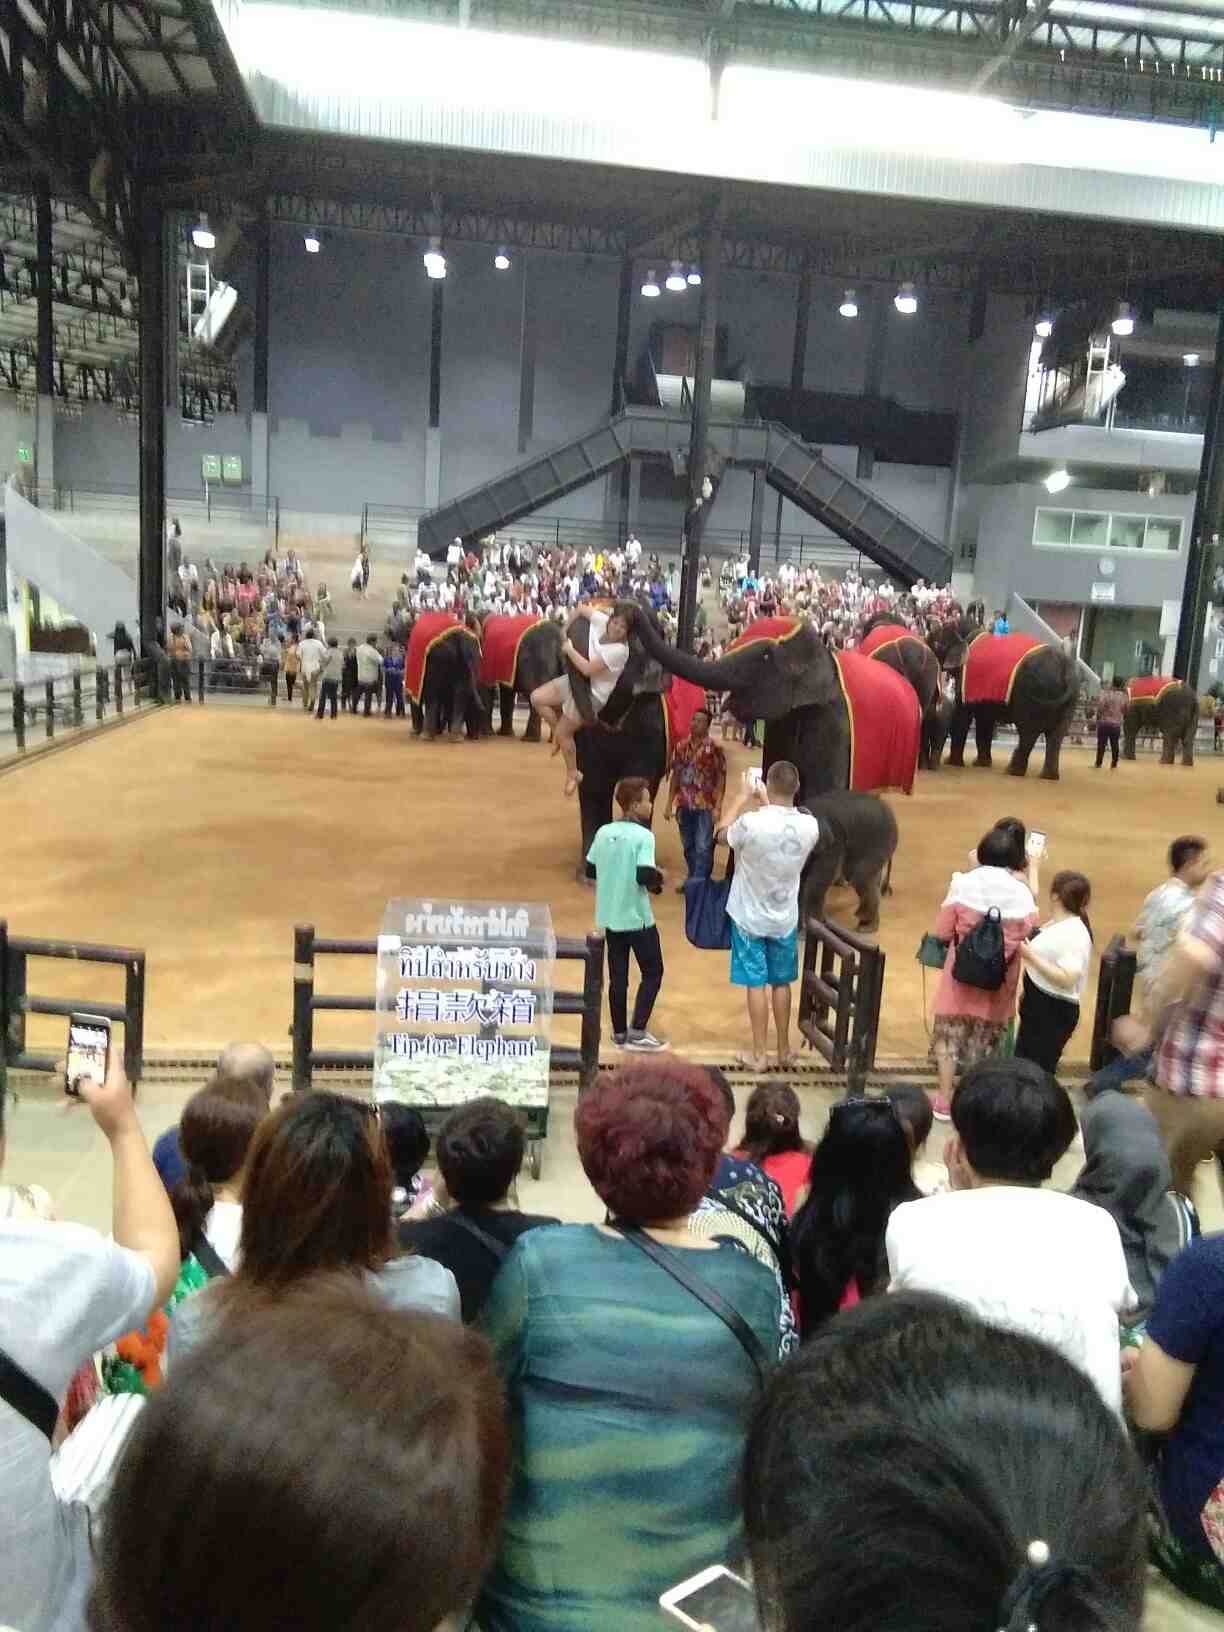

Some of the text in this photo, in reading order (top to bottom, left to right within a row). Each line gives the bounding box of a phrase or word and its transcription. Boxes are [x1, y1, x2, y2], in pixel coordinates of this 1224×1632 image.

[396, 989, 536, 1023] 捐款箱
[390, 1033, 536, 1062] Tip for Elephant
